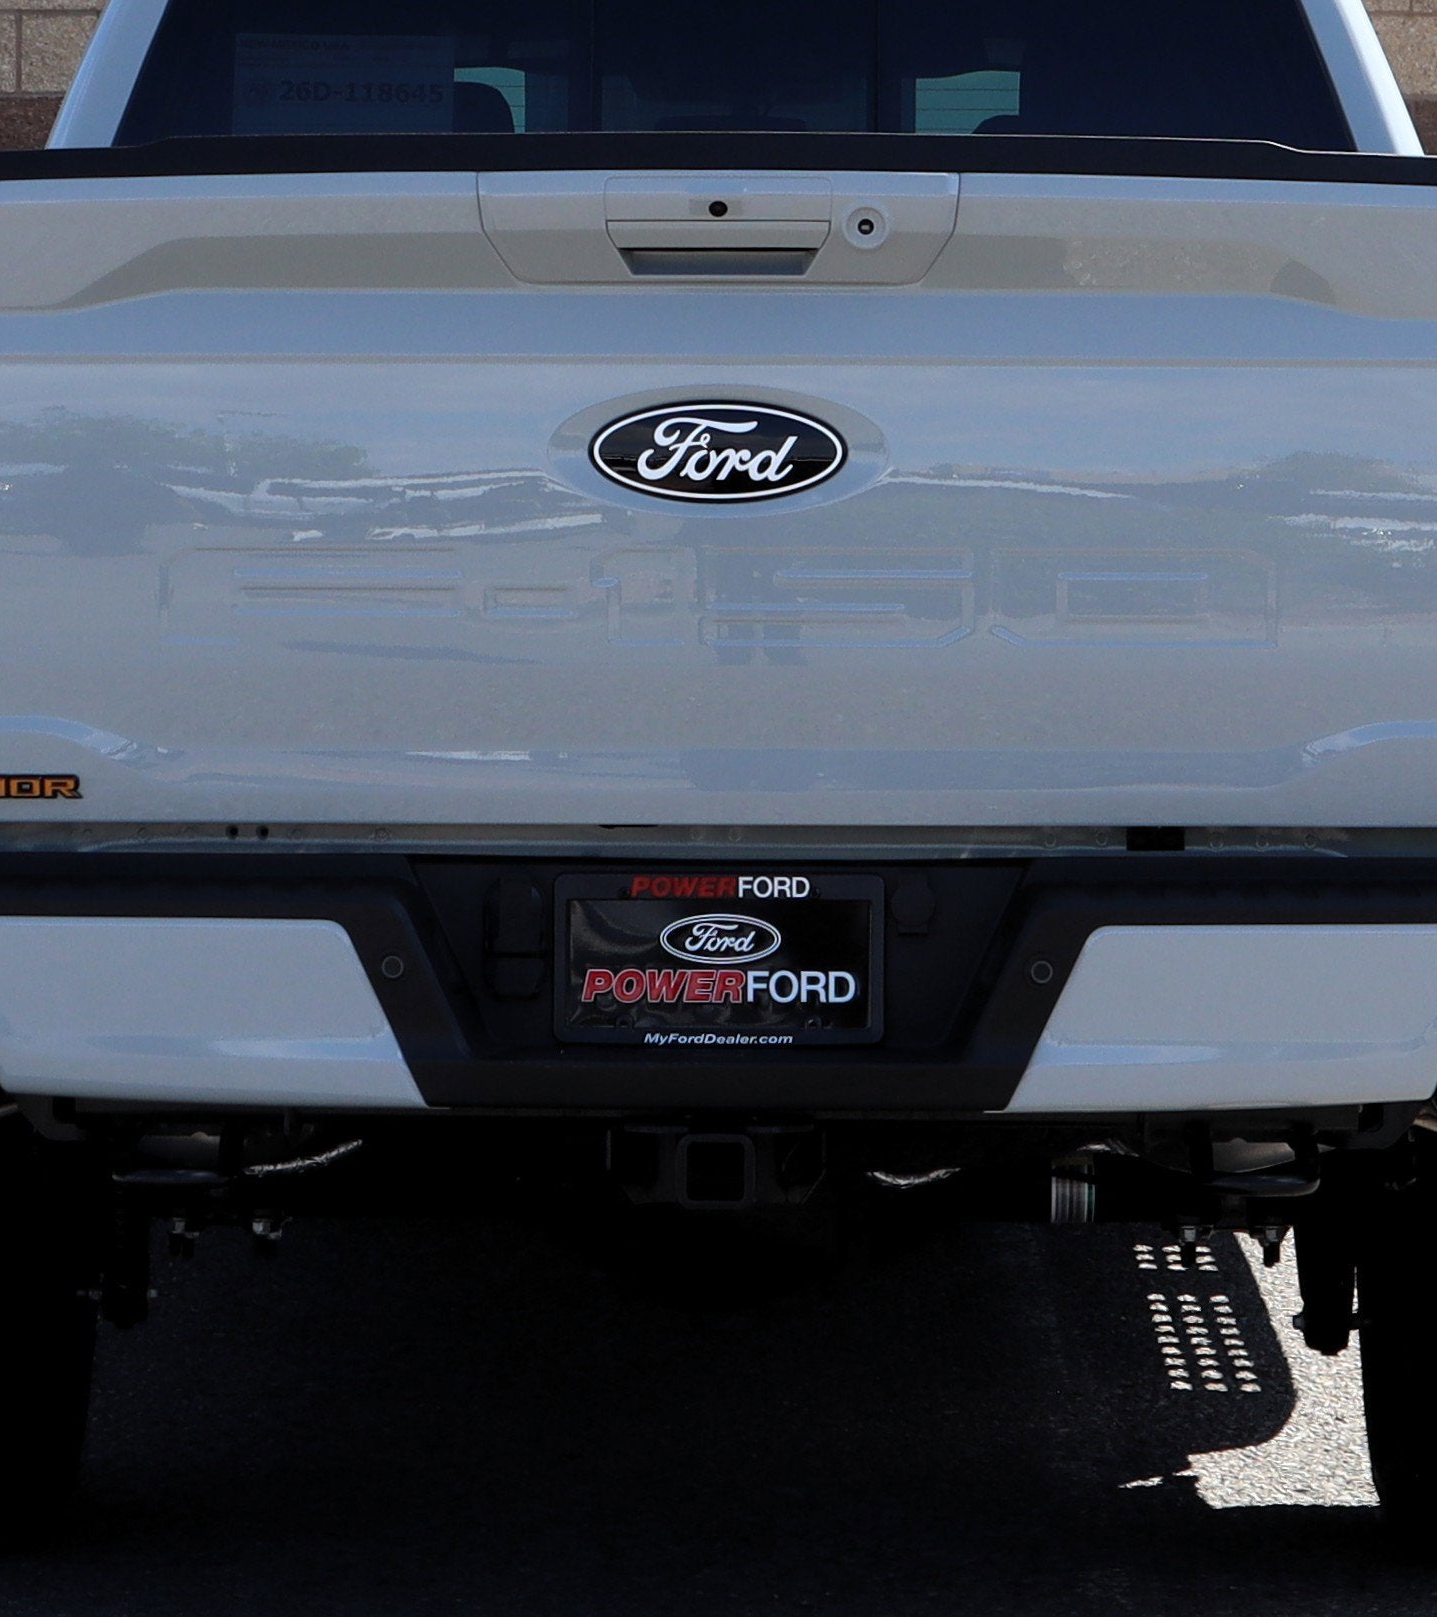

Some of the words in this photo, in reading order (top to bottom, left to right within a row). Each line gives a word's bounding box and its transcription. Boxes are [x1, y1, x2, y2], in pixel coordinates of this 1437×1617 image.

[637, 416, 798, 481] Ford
[630, 876, 810, 899] POWERFORD
[684, 922, 756, 953] Ford
[581, 968, 856, 1004] POWERFORD
[644, 1033, 793, 1045] MyFordDealer.com
